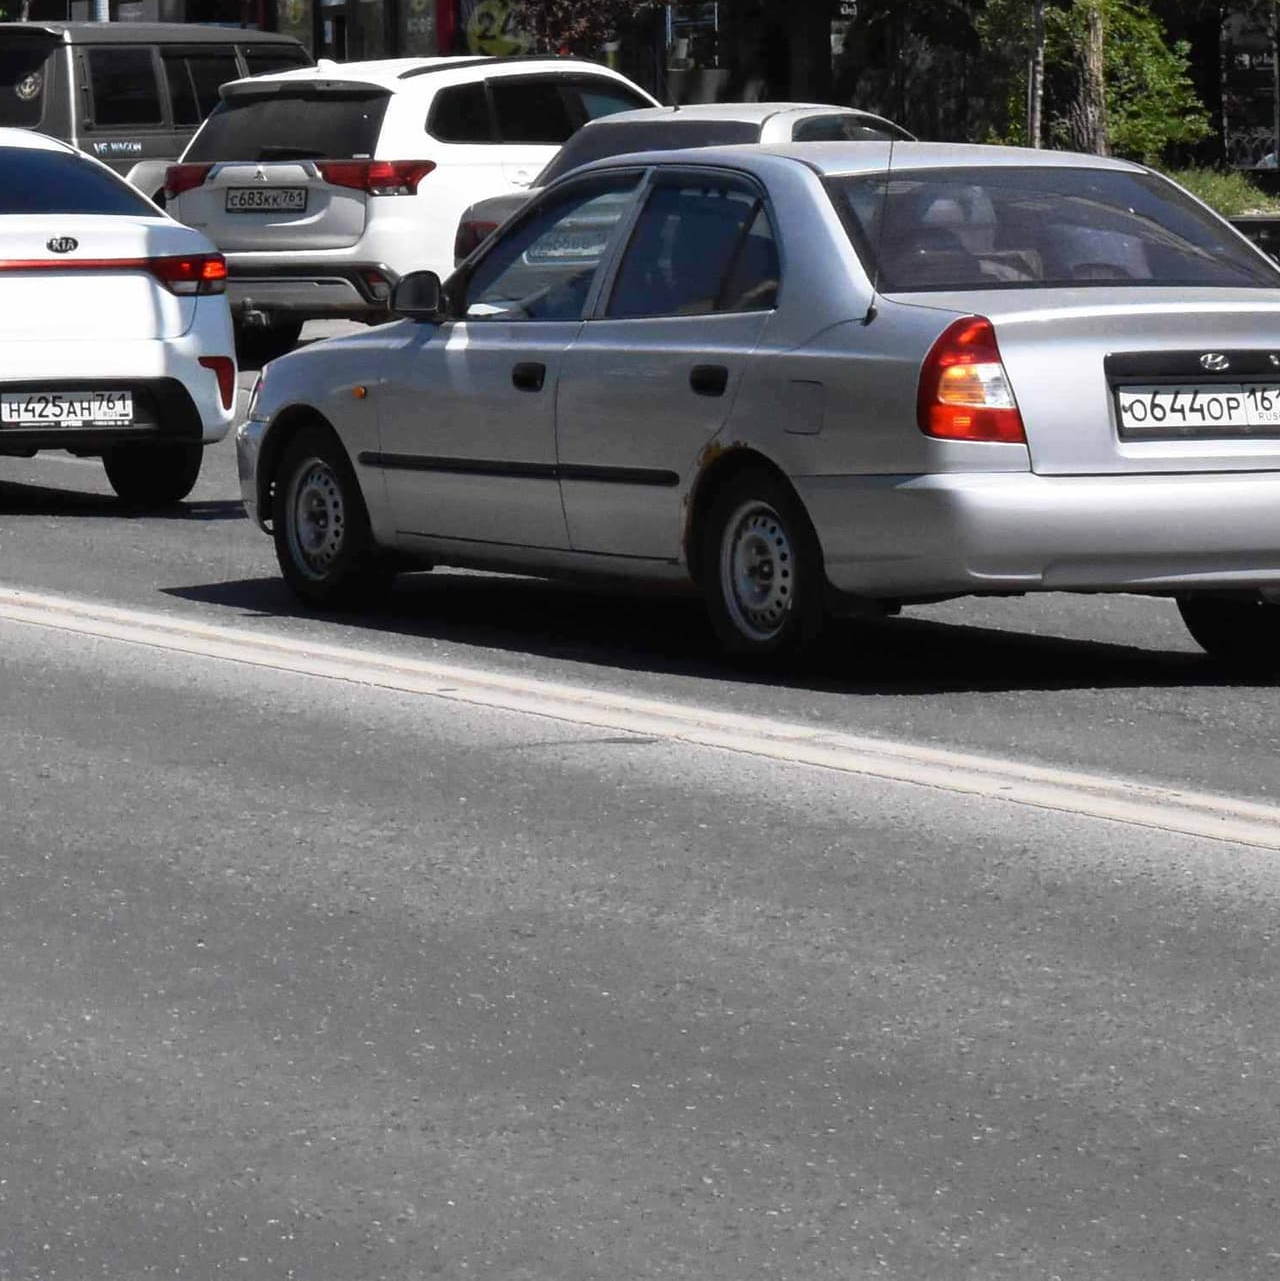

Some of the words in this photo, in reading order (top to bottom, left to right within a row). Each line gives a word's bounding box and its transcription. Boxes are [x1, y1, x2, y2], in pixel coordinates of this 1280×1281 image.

[49, 238, 77, 251] KIA
[8, 395, 92, 419] Н425АН
[95, 393, 127, 411] 761
